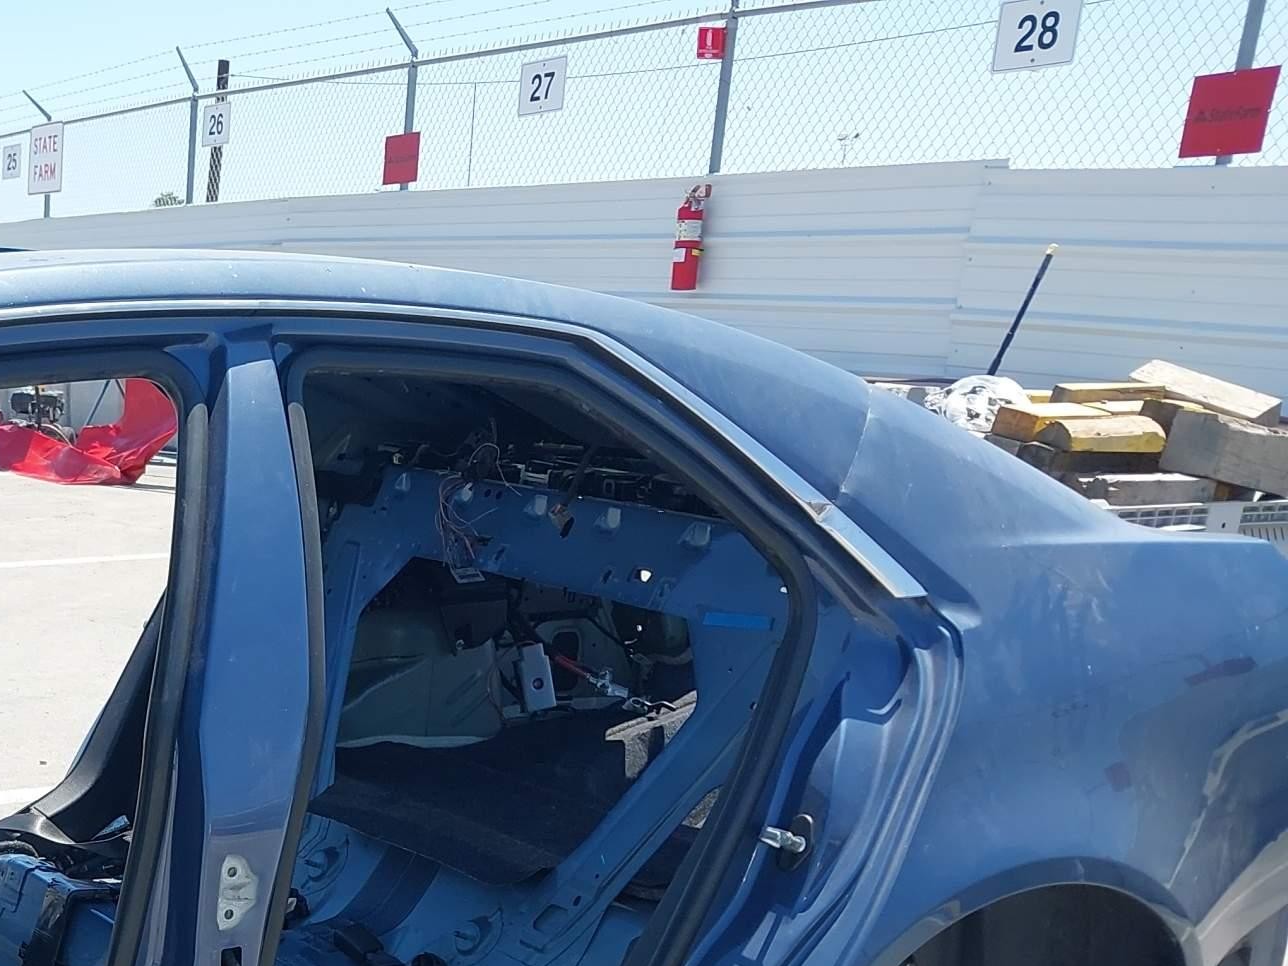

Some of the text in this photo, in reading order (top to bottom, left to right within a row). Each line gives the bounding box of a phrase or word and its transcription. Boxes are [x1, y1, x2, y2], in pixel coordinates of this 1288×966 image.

[1013, 11, 1060, 53] 28
[529, 71, 556, 102] 27
[208, 113, 224, 136] 26
[33, 134, 59, 156] STATE
[6, 152, 17, 171] 25
[33, 162, 57, 182] FARM
